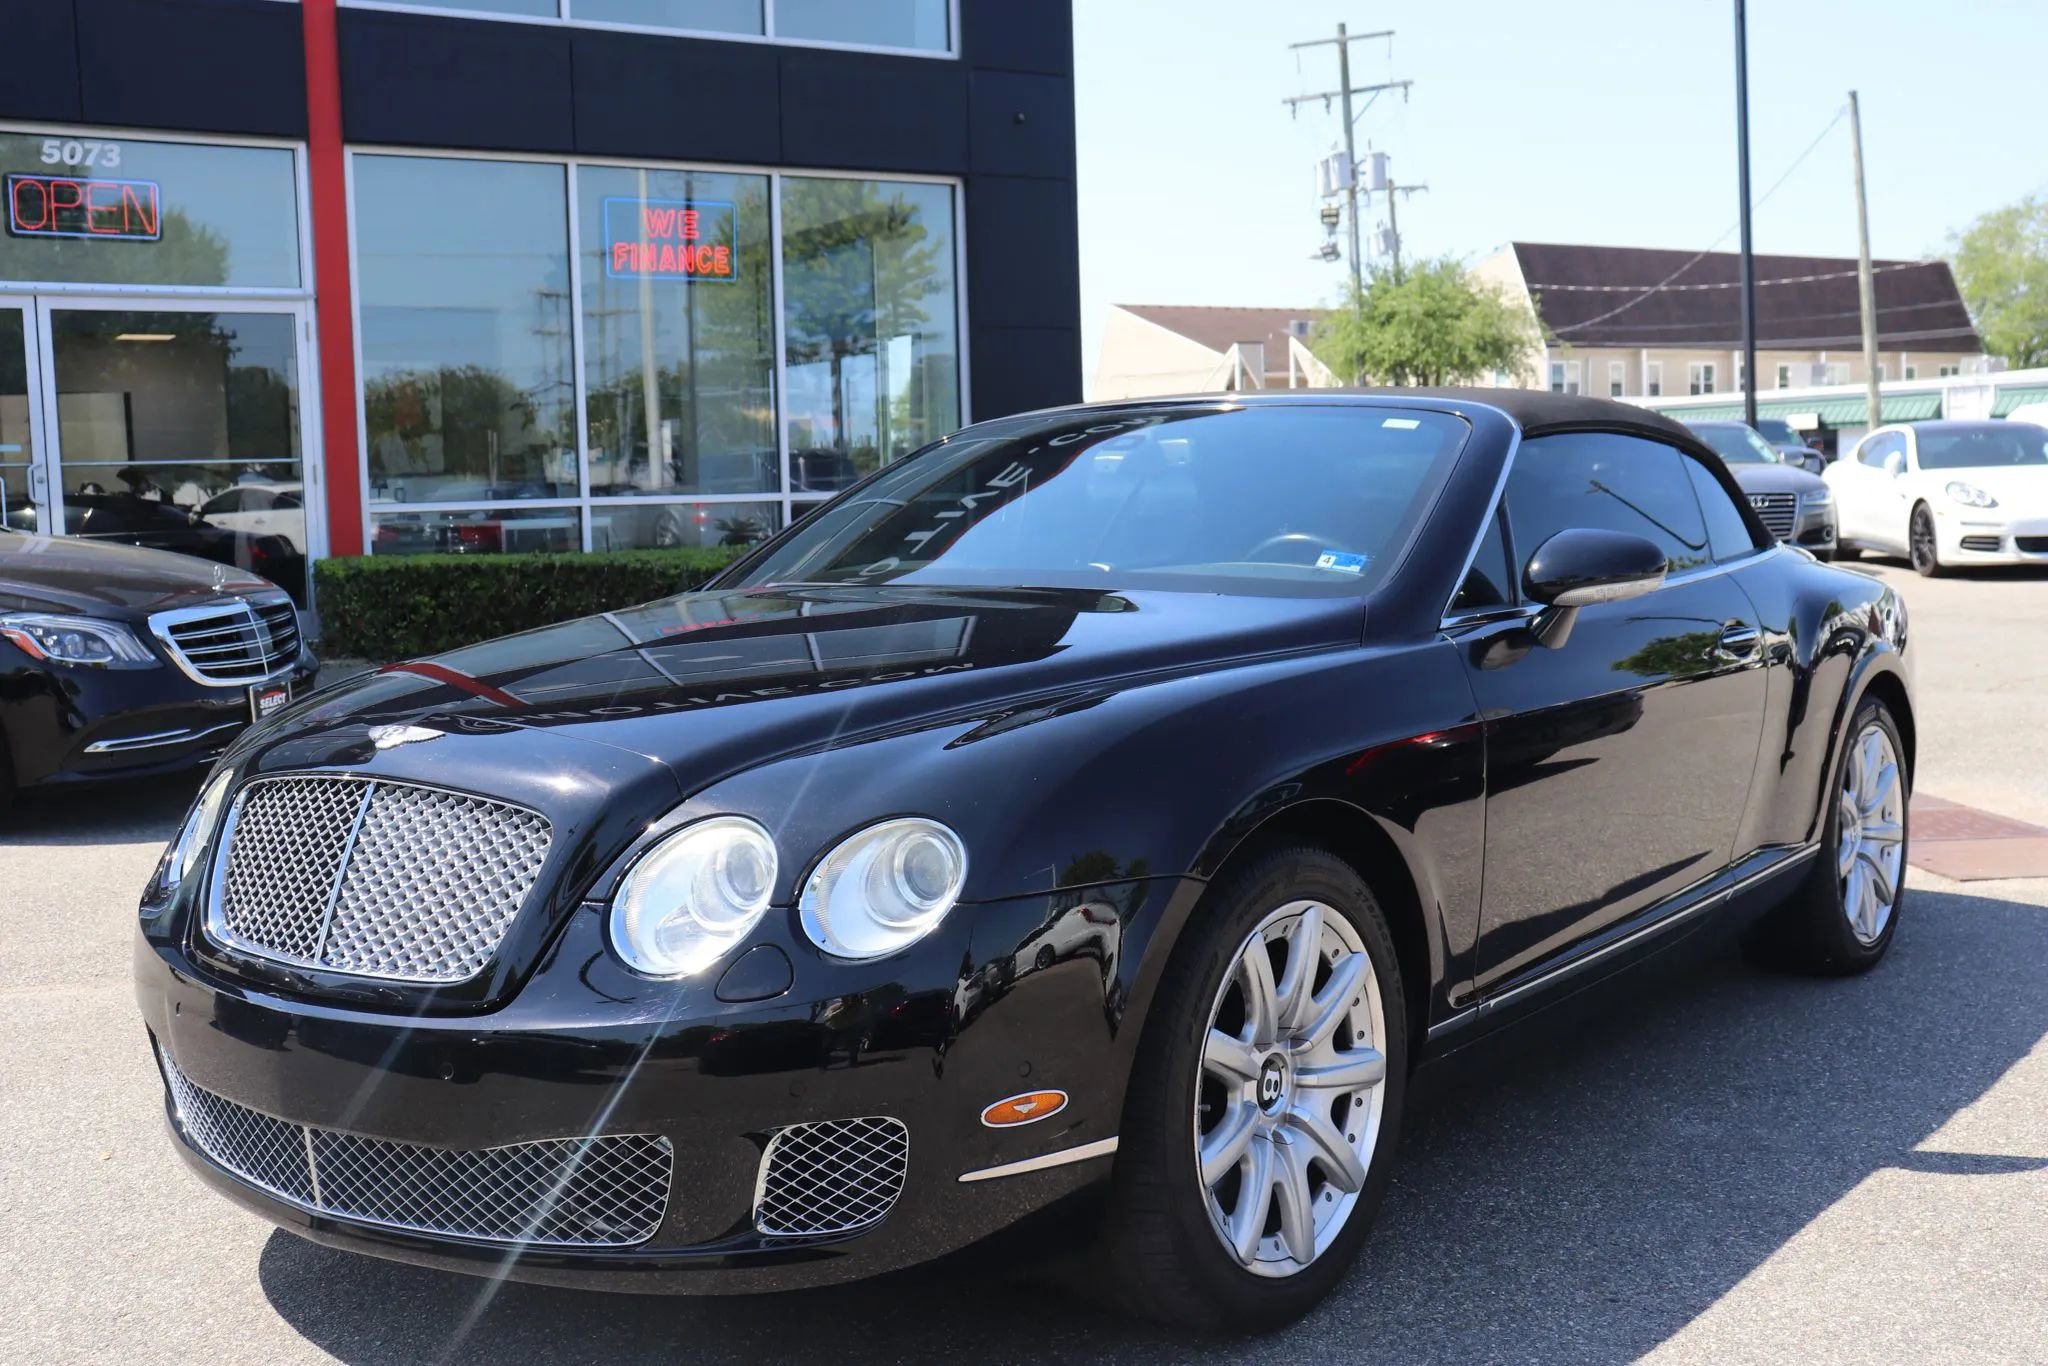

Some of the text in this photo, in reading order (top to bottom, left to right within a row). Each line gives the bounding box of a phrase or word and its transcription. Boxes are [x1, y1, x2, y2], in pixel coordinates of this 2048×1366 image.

[40, 140, 121, 168] 5073
[13, 179, 157, 234] OPEN
[643, 208, 700, 240] WE
[613, 242, 731, 274] FINANCE
[260, 692, 287, 709] SELECT
